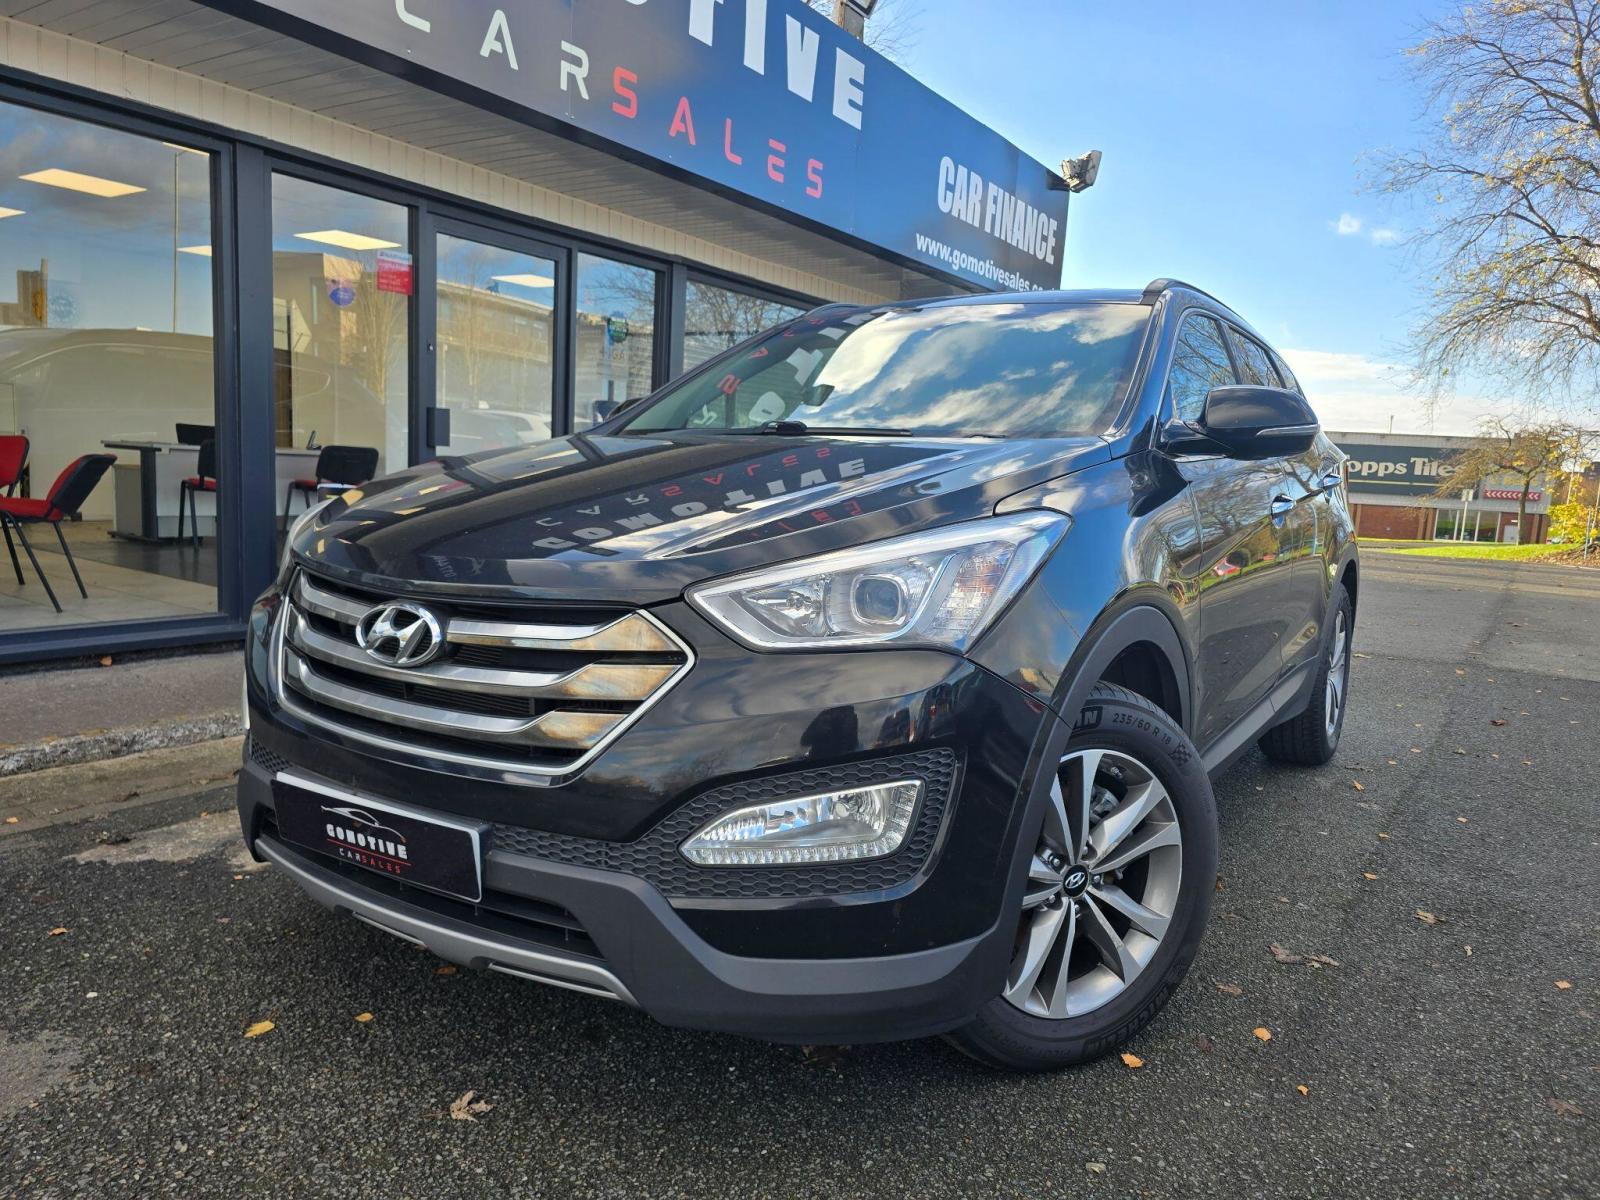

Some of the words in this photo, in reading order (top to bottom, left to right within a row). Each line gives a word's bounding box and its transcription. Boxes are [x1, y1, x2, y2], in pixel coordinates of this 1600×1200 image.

[624, 0, 865, 130] IVE
[937, 156, 983, 229] CAR
[984, 181, 1058, 265] FINANCE
[1345, 454, 1407, 477] opps
[1112, 712, 1150, 732] 235/60
[1152, 727, 1160, 737] R
[1162, 733, 1172, 745] 18
[326, 823, 408, 860] GOMOTIVE
